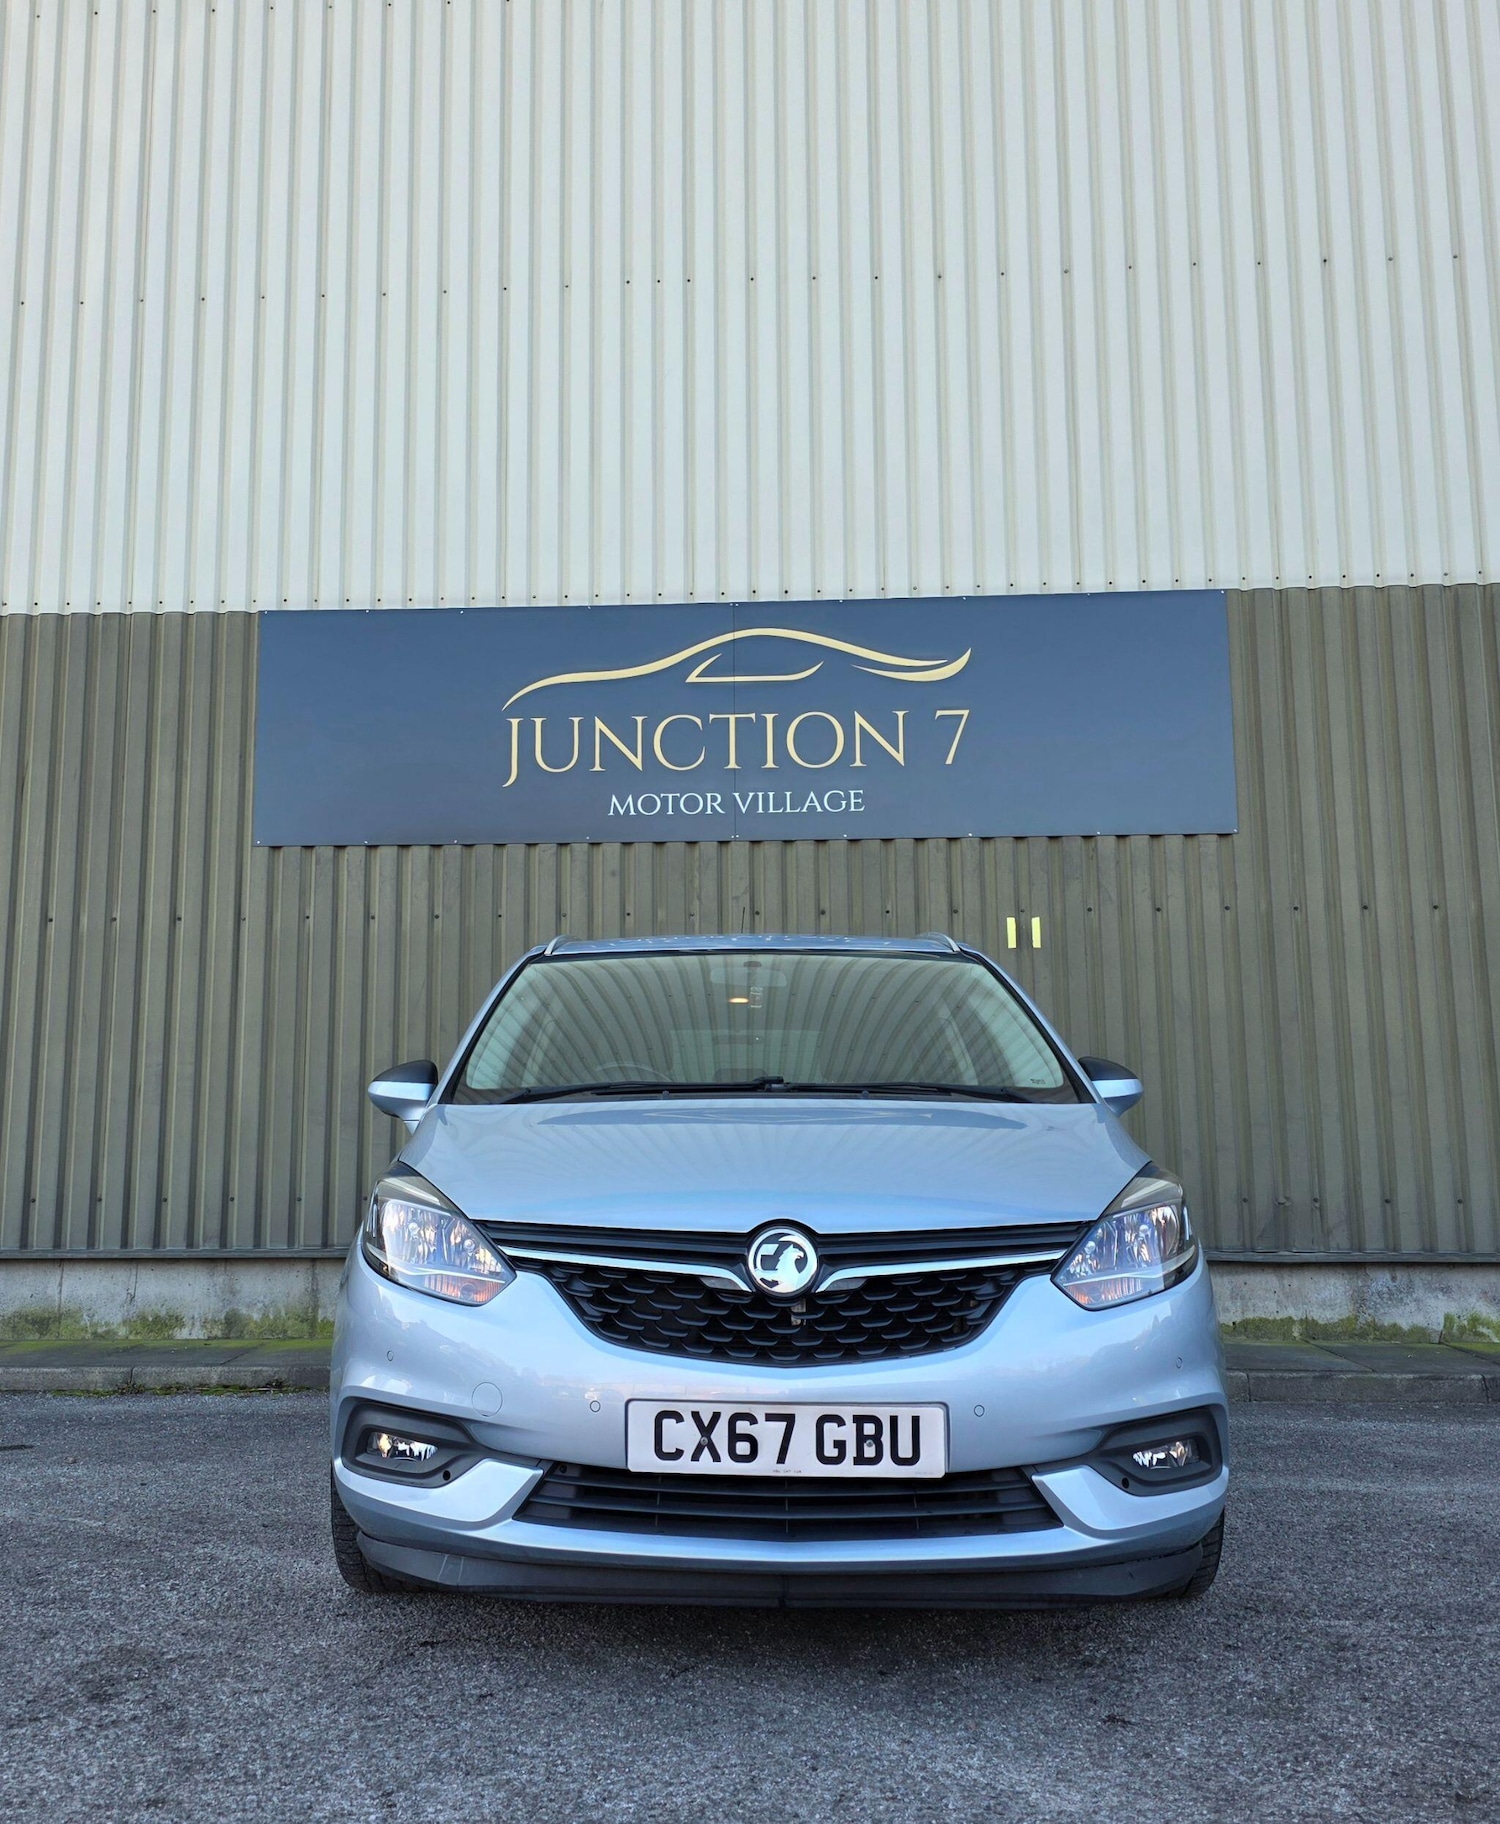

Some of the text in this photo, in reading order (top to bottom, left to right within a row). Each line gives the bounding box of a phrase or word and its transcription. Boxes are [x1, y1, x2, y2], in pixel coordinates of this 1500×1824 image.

[502, 709, 970, 789] JUNCTION 7
[608, 789, 865, 816] MOTOR VILLAGE
[654, 1409, 921, 1467] CX67 GBU
